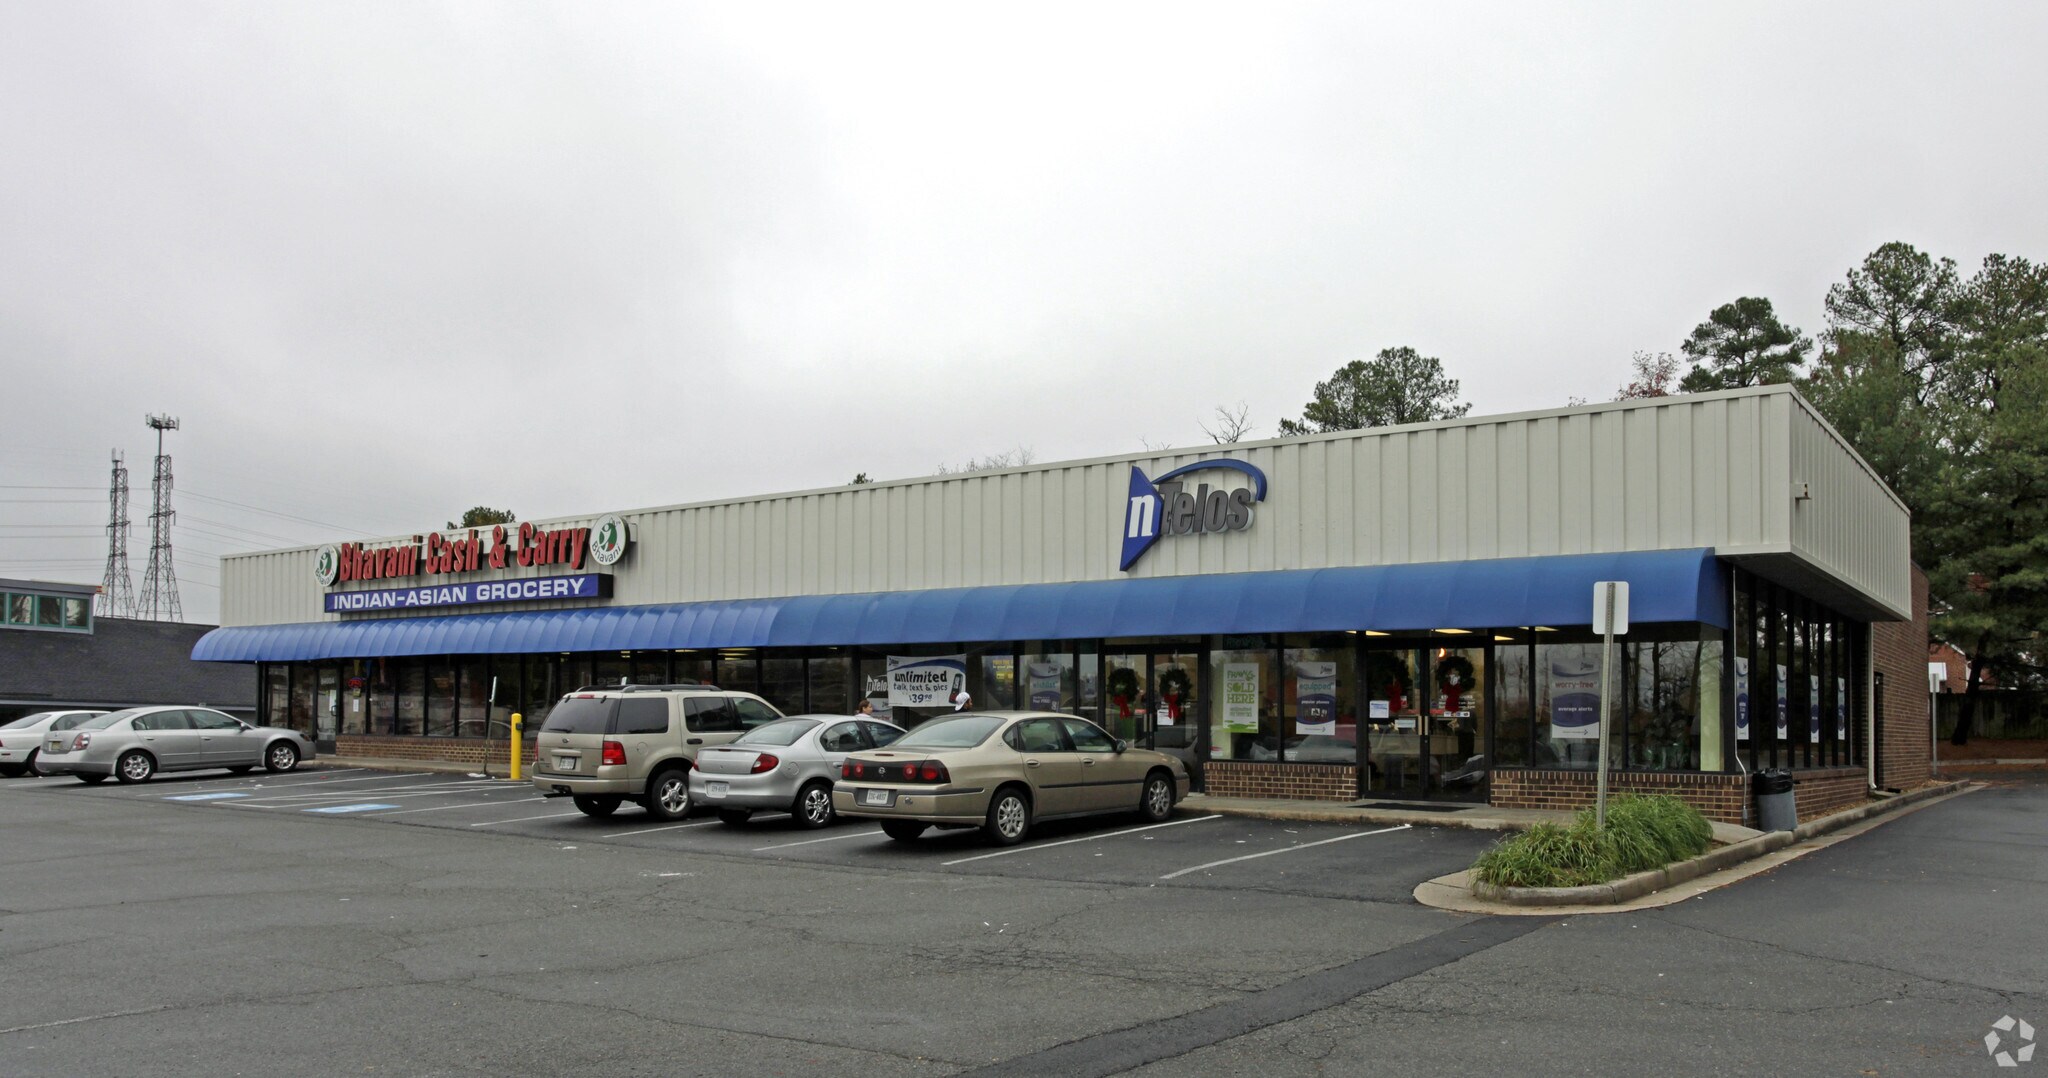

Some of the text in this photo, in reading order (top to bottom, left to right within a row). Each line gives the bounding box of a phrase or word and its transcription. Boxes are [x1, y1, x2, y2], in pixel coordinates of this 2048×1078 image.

[1128, 481, 1251, 538] nTelos
[340, 521, 586, 581] Bhavani Cash & Carry
[592, 540, 621, 563] Bhavani
[334, 577, 585, 609] INDIAN-ASIAN GROCERY
[894, 670, 947, 683] unlimited
[909, 683, 923, 691] text
[933, 683, 948, 692] pics
[1226, 693, 1255, 704] HERE
